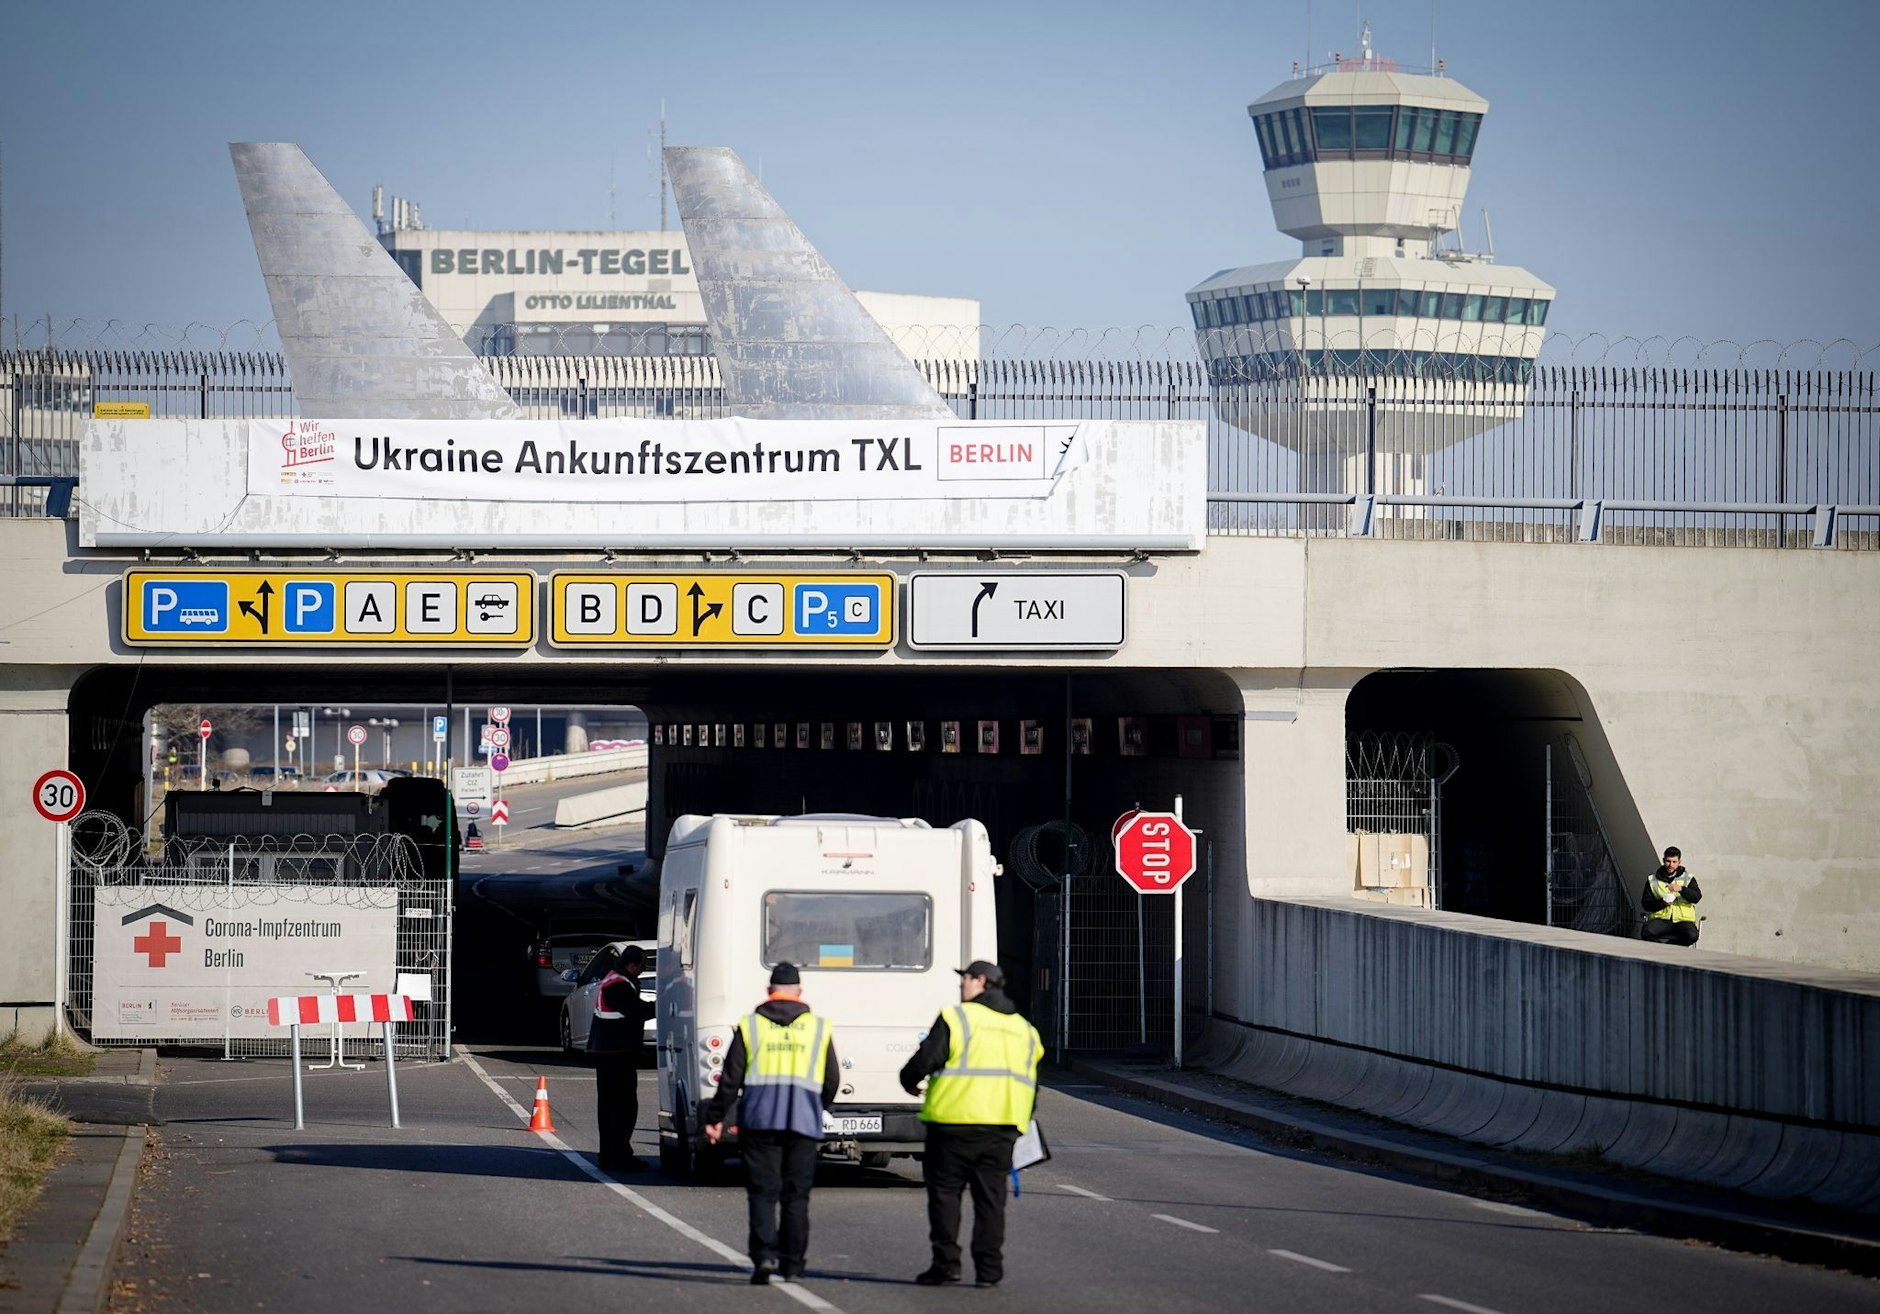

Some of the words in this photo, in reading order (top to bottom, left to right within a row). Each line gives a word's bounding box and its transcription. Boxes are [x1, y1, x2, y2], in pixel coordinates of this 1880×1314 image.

[430, 249, 690, 275] BERLIN-TEGEL
[525, 295, 573, 310] OTTO
[576, 295, 676, 310] LILIENTHAL
[300, 420, 320, 433] Wir
[300, 431, 335, 446] helfen
[300, 443, 335, 459] Berlin
[354, 436, 502, 474] Ukraine
[515, 439, 841, 475] Ankunftszentrum
[852, 437, 922, 472] TXL
[949, 444, 1033, 464] BERLIN
[151, 587, 178, 626] P
[296, 587, 323, 626] P
[358, 593, 383, 623] A
[421, 594, 441, 623] E
[580, 594, 602, 623] B
[641, 594, 663, 624] D
[747, 594, 769, 624] C
[851, 601, 863, 618] C
[1013, 599, 1065, 620] TAXI
[352, 730, 362, 740] 30
[436, 719, 444, 732] P
[495, 733, 506, 742] 30
[44, 784, 74, 808] 30
[1141, 822, 1171, 884] STOP
[205, 917, 342, 941] Corona-Impfzentrum
[204, 949, 245, 968] Berlin
[842, 1119, 857, 1131] RD
[859, 1119, 880, 1131] 666
